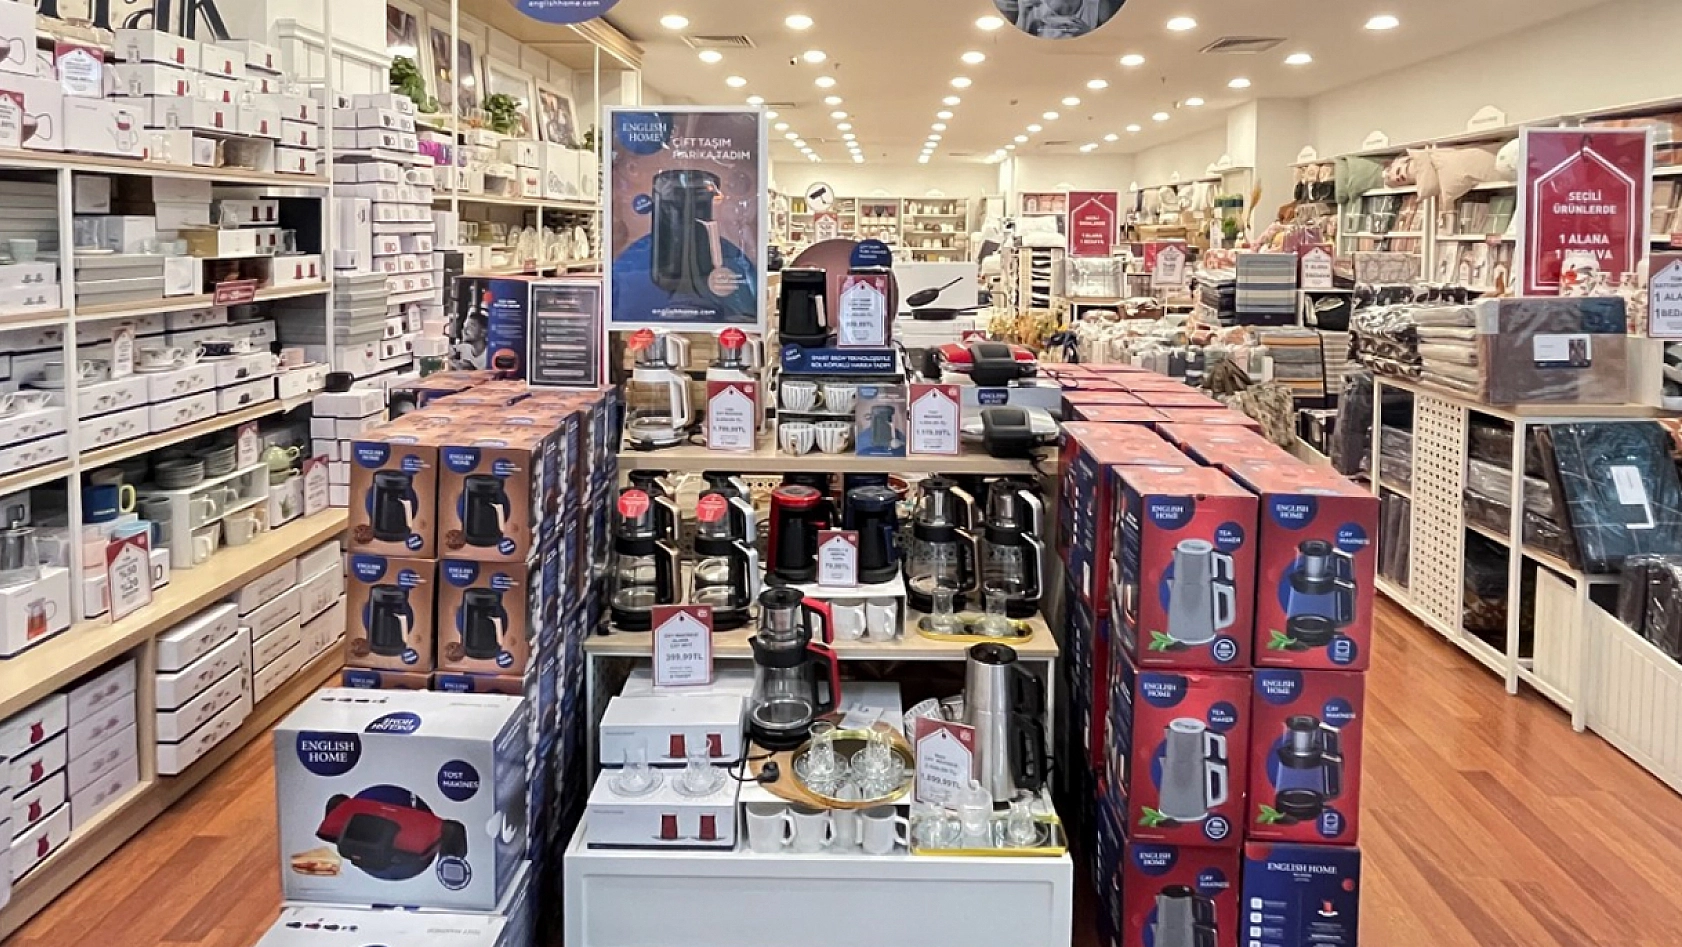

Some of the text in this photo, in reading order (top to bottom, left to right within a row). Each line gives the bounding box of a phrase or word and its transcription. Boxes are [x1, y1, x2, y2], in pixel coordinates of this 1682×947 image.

[622, 122, 667, 132] ENGLISH
[629, 133, 661, 142] HOME
[672, 136, 732, 149] ÇİFT TAŞIM
[716, 150, 751, 160] TADIM
[1568, 188, 1602, 203] SEÇİLİ
[1552, 202, 1617, 215] ÜRÜNLERDE
[1558, 233, 1610, 244] 1 ALANA
[1554, 249, 1562, 259] 1
[651, 307, 716, 317] englishhome.com
[1661, 308, 1682, 317] BED
[449, 453, 475, 461] ENGLISH
[1151, 504, 1184, 514] ENGLISH
[1276, 503, 1309, 513] ENGLISH
[1155, 511, 1178, 520] HOME
[1280, 511, 1304, 519] HOME
[1143, 682, 1177, 691] ENGLISH
[1262, 679, 1295, 688] ENGLISH
[1148, 690, 1171, 698] HOME
[1267, 686, 1291, 695] HOME
[301, 739, 355, 752] ENGLISH
[308, 750, 348, 763] HOME
[442, 770, 464, 779] TOST
[1139, 851, 1171, 860] ENGLISH
[1143, 858, 1166, 866] HOME
[1267, 861, 1338, 875] ENGLISH HOME
